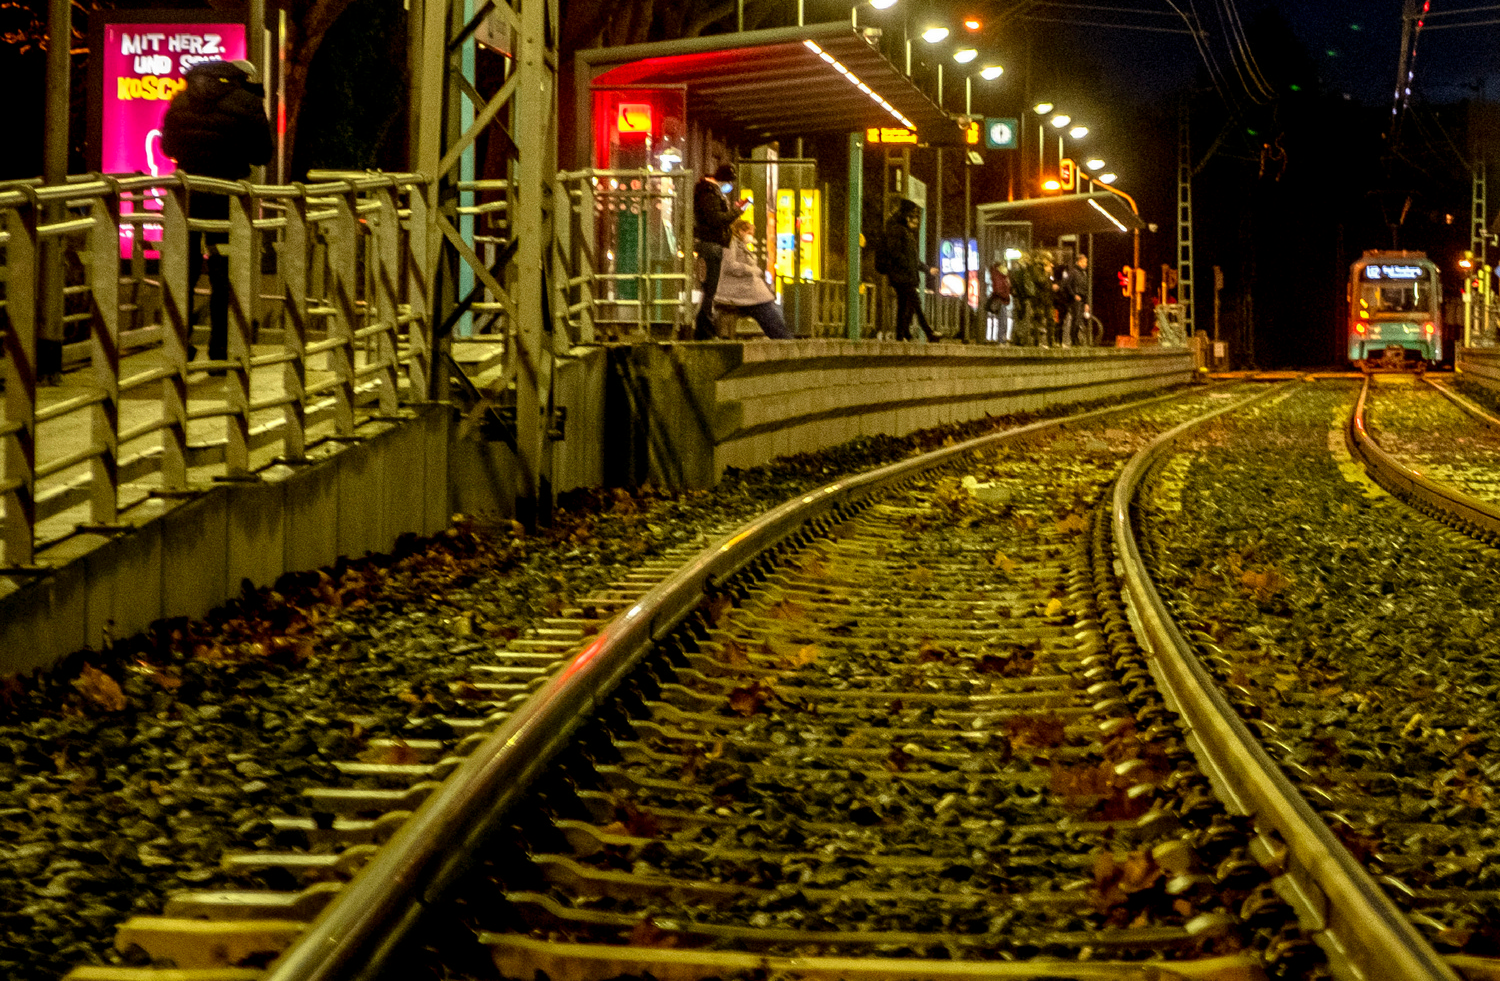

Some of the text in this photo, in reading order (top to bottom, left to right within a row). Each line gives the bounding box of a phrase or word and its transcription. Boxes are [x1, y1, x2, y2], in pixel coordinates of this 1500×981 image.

[121, 33, 226, 55] MIT HERZ.
[133, 54, 172, 75] UND
